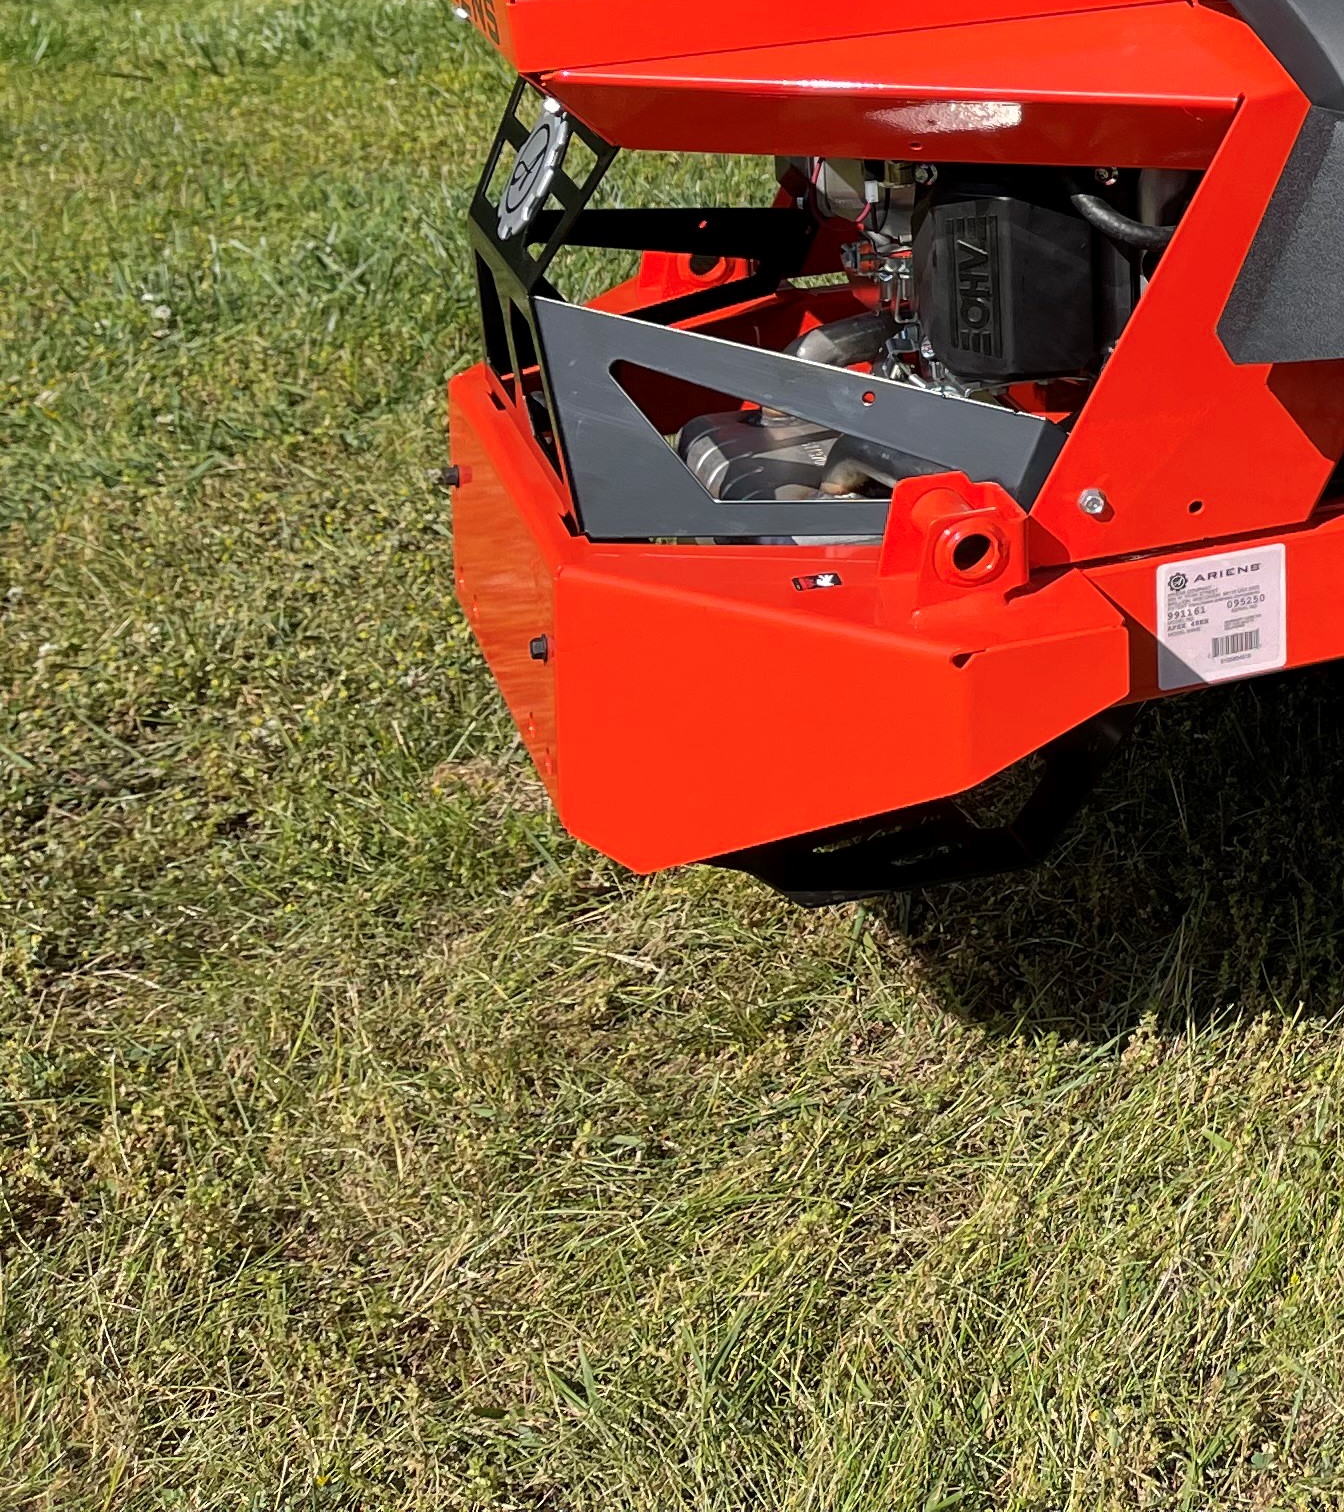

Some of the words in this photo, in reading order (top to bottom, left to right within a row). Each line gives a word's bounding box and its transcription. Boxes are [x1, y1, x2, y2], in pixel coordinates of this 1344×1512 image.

[958, 240, 991, 329] OHV
[1194, 563, 1262, 583] ARIENS
[1167, 604, 1205, 620] 991161
[1226, 593, 1265, 608] 095250
